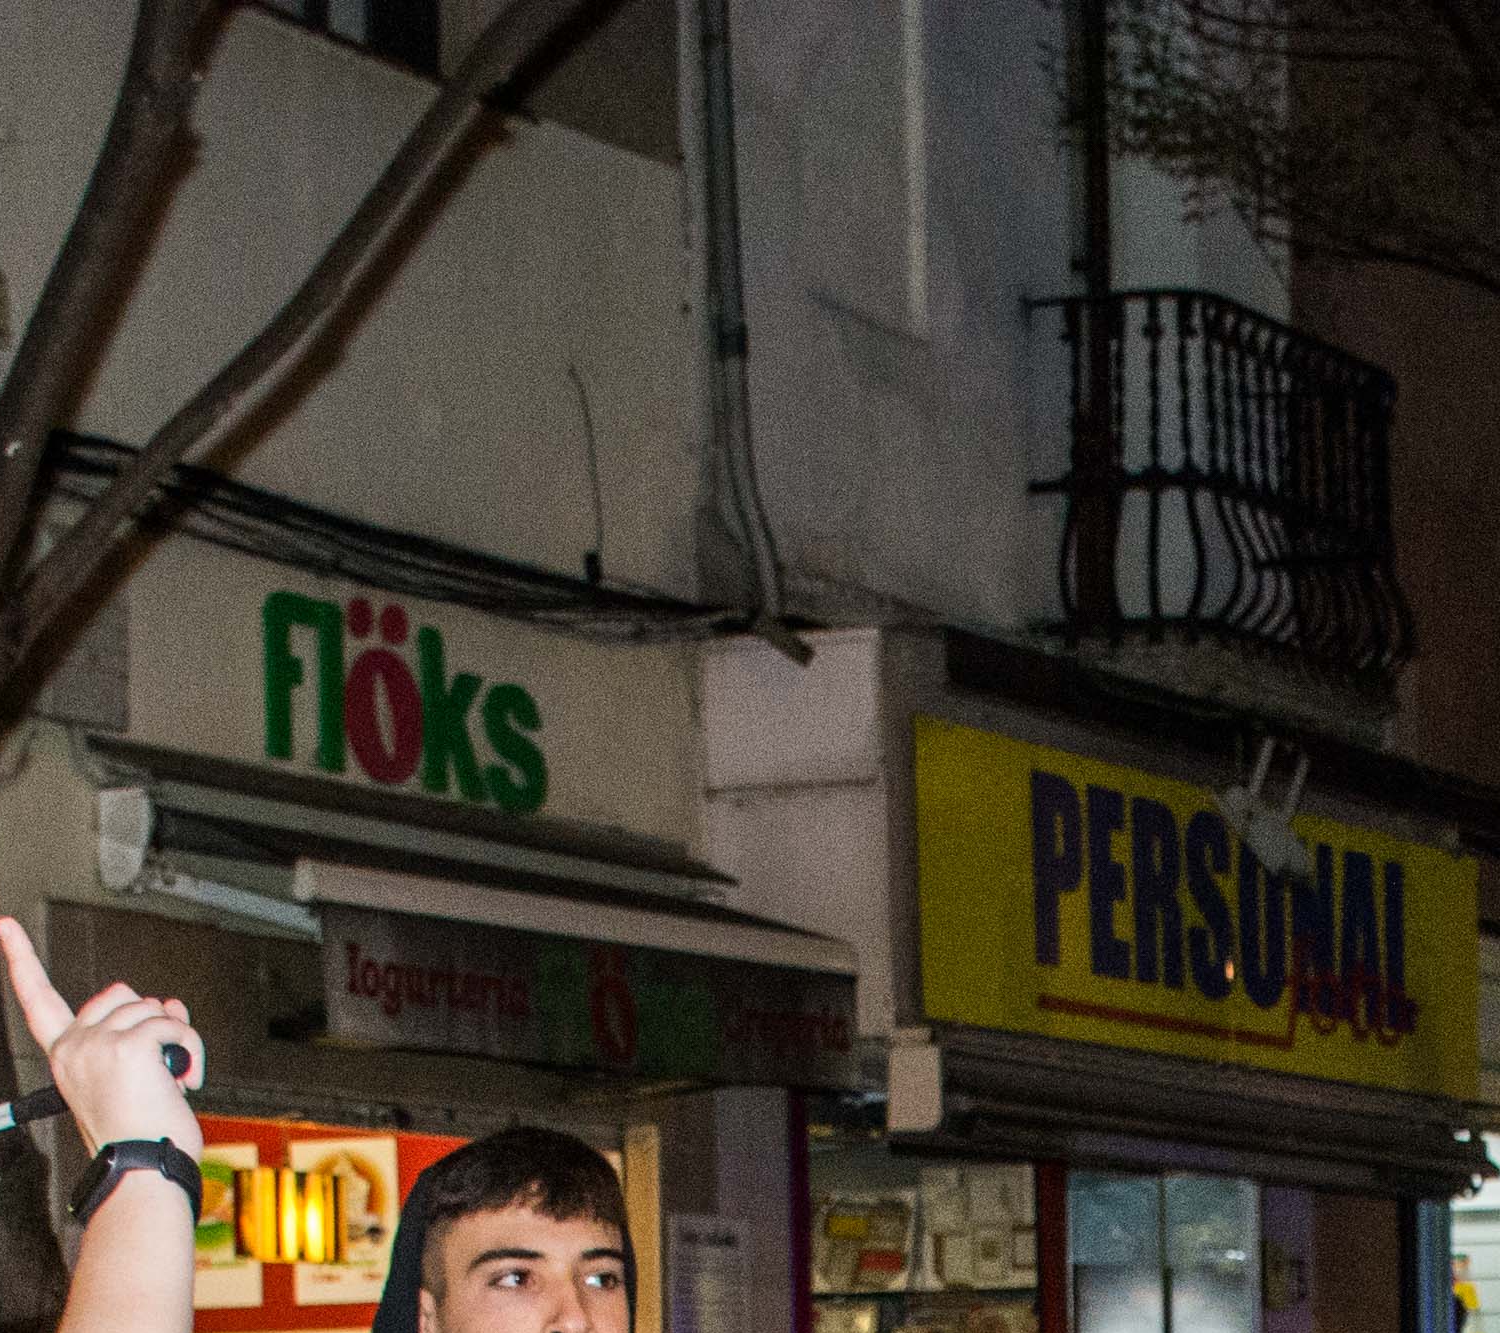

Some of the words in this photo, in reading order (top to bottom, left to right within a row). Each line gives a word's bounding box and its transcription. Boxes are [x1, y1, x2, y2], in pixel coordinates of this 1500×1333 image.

[261, 590, 549, 815] Flöks
[346, 941, 531, 1018] Iogurteria
[1031, 768, 1410, 1014] PERSONAL
